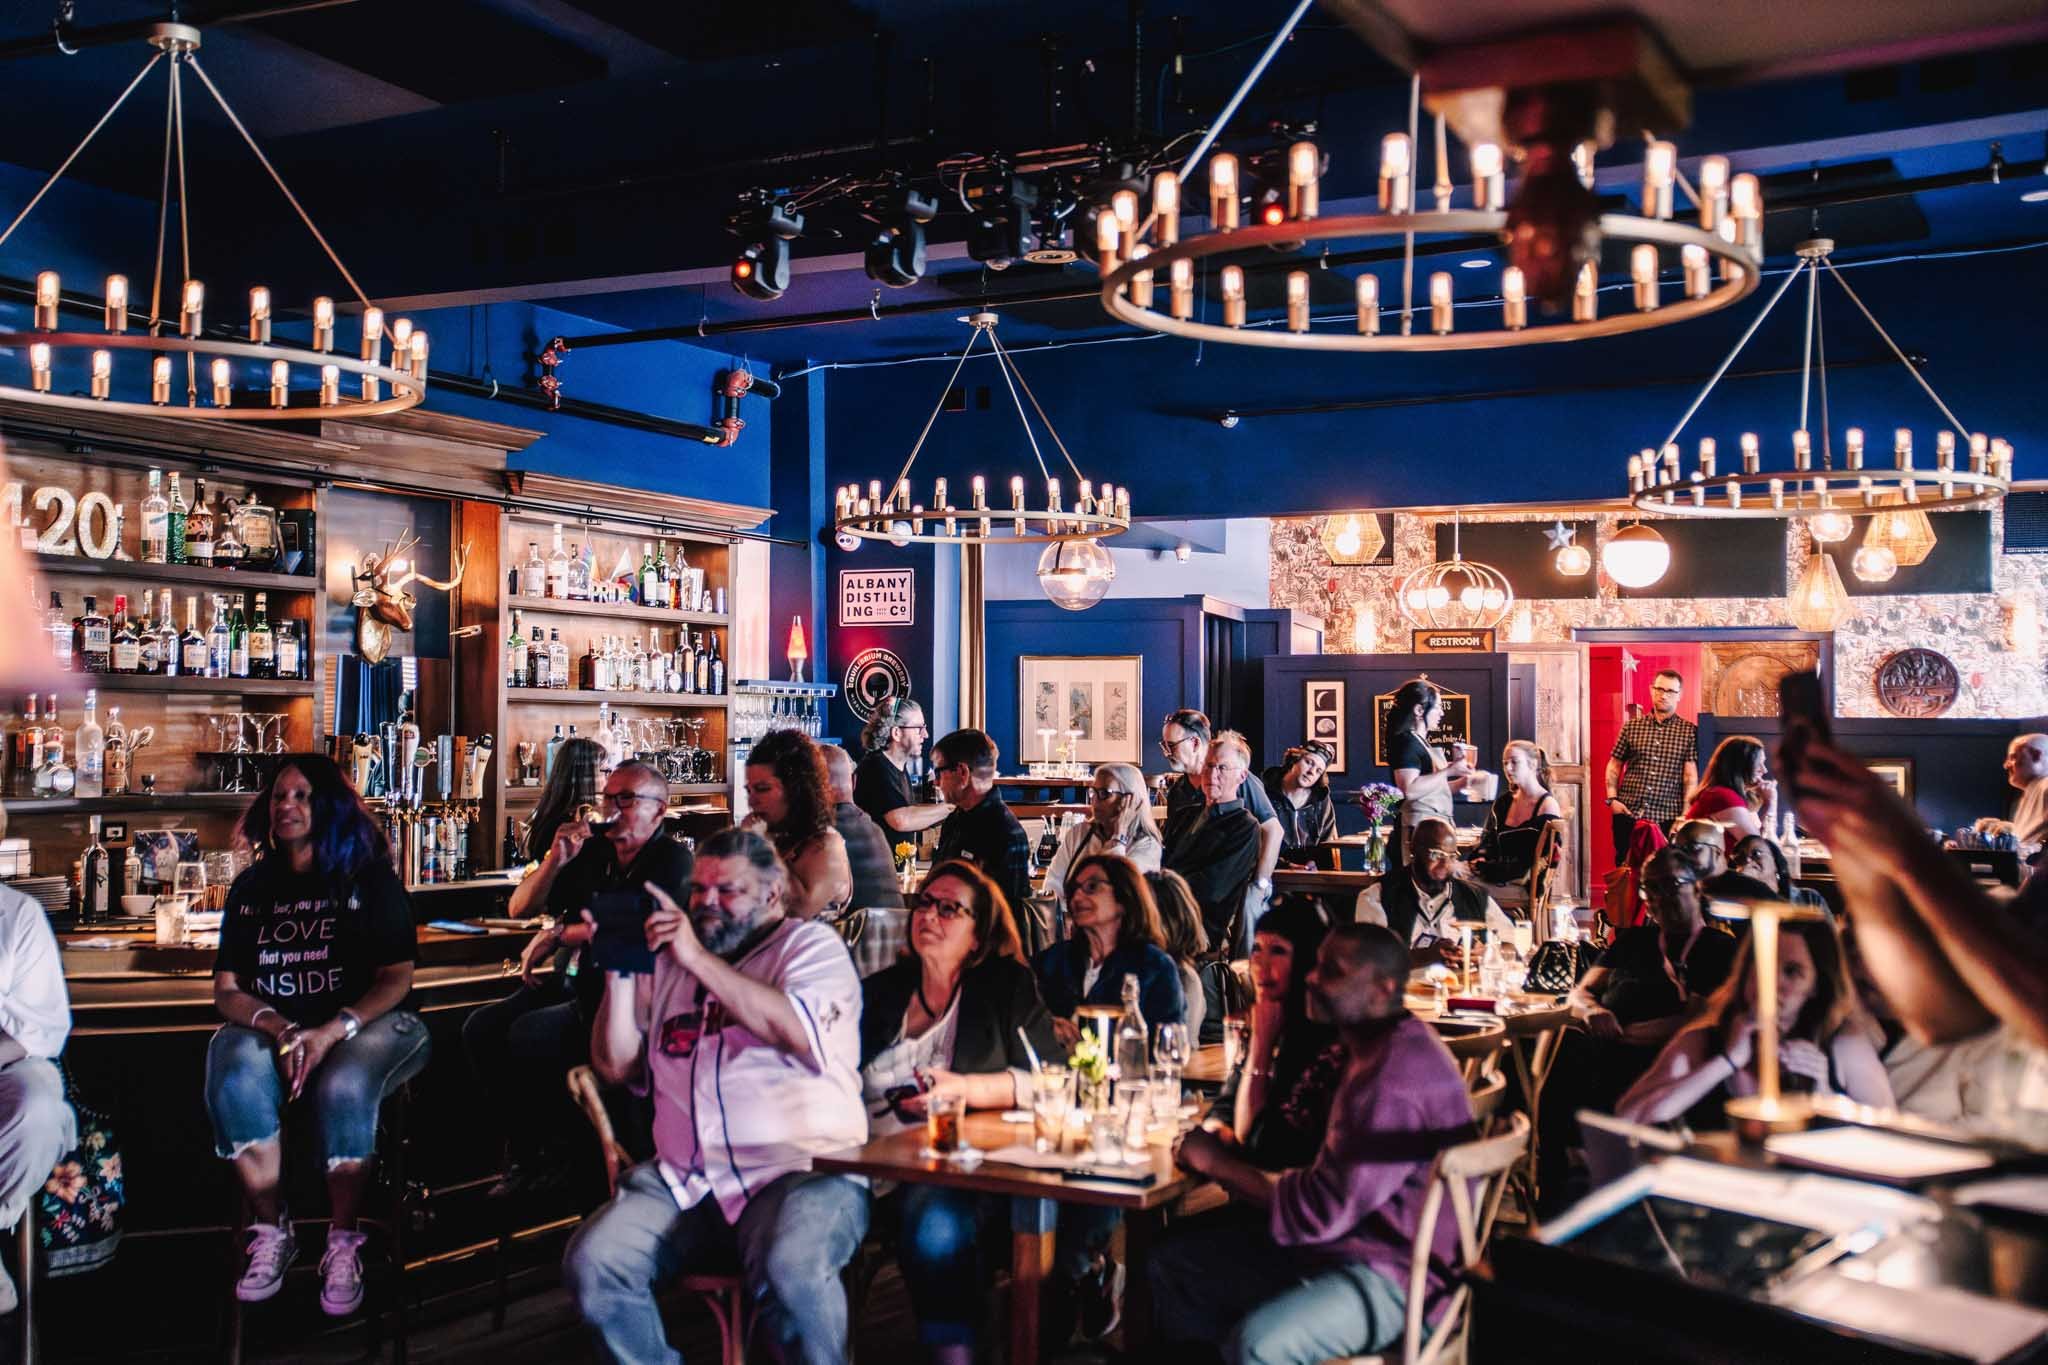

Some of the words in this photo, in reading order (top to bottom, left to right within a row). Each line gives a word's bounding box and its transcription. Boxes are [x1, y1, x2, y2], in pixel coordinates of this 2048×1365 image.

[846, 577, 907, 589] ALBANY
[846, 592, 907, 603] DISTILL
[847, 605, 873, 617] ING
[1430, 637, 1480, 647] RESTROOM
[848, 652, 882, 688] EQUILIBRIUM
[883, 654, 907, 687] BREWERY
[257, 918, 336, 945] LOVE
[259, 950, 279, 966] that
[282, 952, 301, 966] you
[303, 945, 328, 962] need
